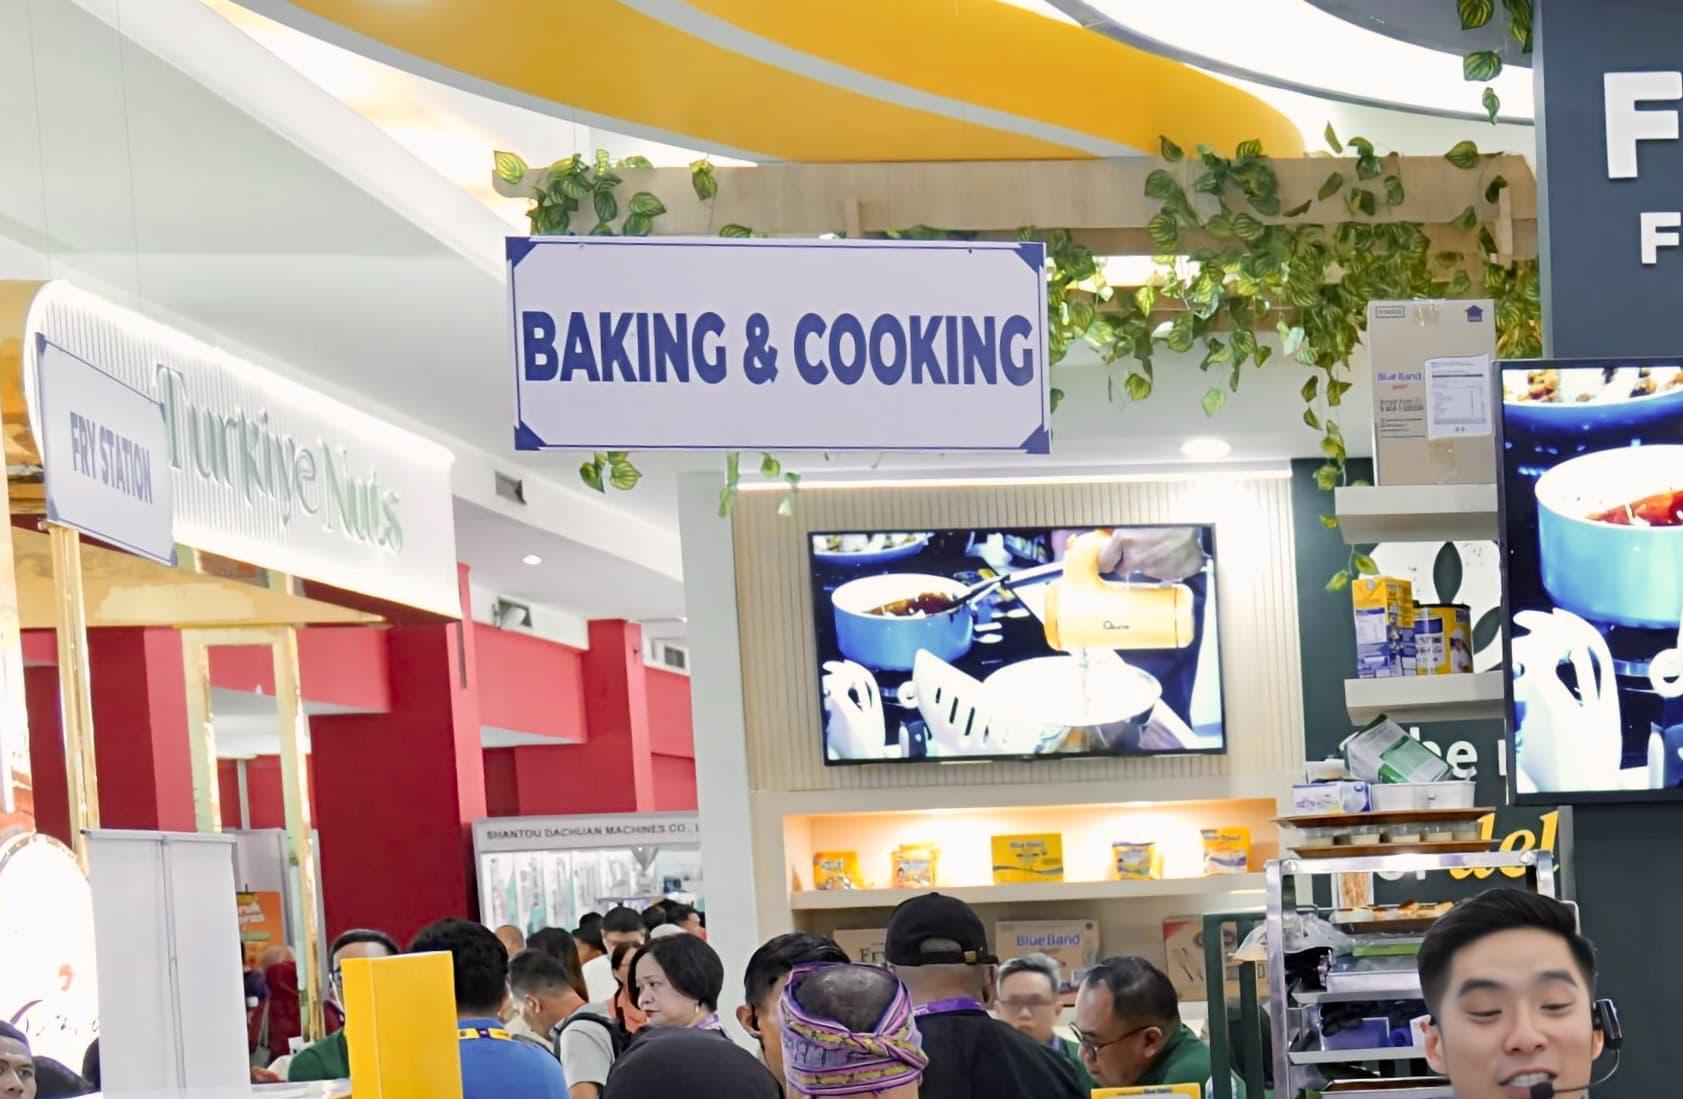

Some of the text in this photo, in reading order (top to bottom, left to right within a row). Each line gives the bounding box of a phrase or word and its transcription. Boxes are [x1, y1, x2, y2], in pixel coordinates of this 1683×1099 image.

[522, 311, 1034, 386] BAKING & COOKING
[69, 410, 153, 505] FRY STATION
[487, 829, 542, 840] SHANTOU
[545, 827, 602, 837] DACHUAN
[605, 824, 666, 835] MACHINES
[1016, 933, 1080, 946] Blue Band
